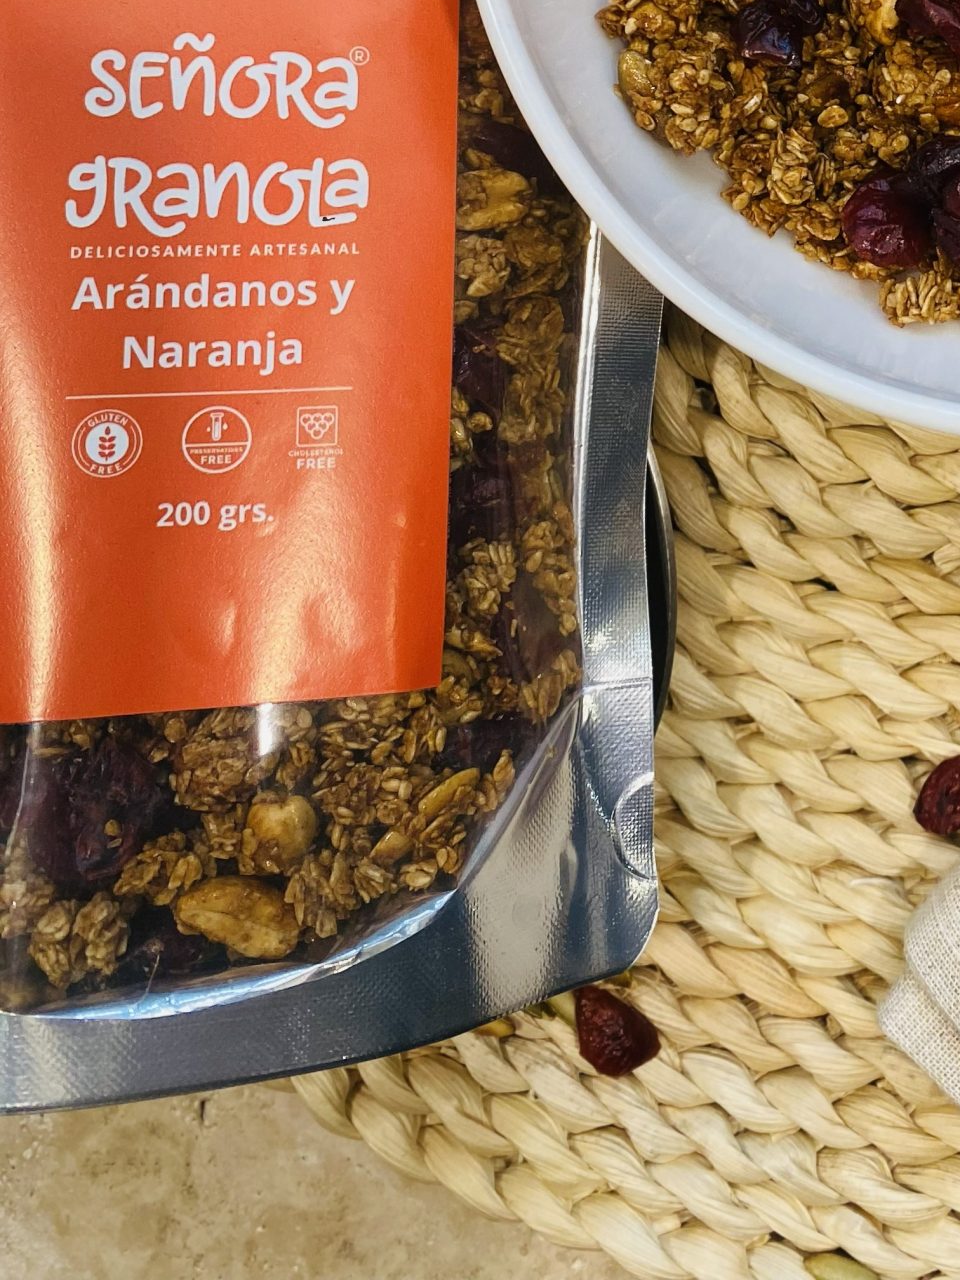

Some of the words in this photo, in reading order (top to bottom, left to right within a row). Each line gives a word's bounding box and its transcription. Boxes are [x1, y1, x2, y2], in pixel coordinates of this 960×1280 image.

[69, 244, 242, 259] DELICIOSAMENTE
[249, 242, 361, 258] ARTESANAL
[71, 273, 318, 311] Arándanos
[329, 278, 356, 316] y
[122, 331, 303, 377] Naranja
[86, 412, 129, 428] GLUTEN
[200, 454, 232, 466] FREE
[296, 456, 336, 470] FREE
[88, 462, 123, 475] FREE
[156, 500, 211, 528] 200
[217, 501, 275, 532] grs.
